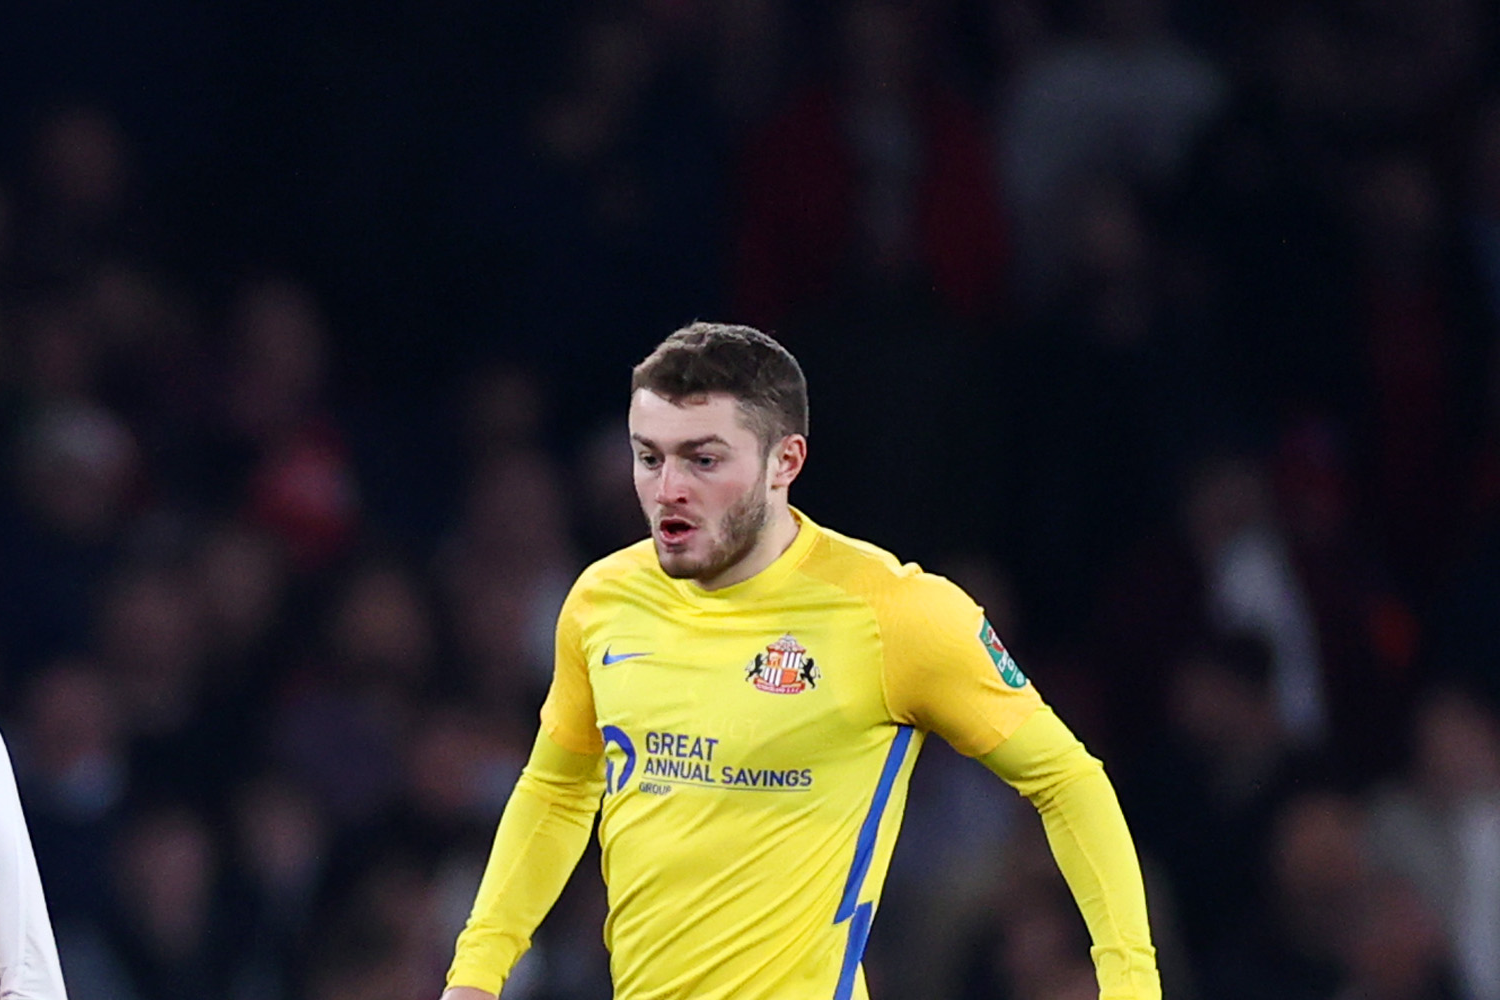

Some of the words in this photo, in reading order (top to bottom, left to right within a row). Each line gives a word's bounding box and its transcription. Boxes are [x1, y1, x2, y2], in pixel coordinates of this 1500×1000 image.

[645, 732, 719, 761] GREAT
[643, 757, 715, 783] ANNUAL
[721, 766, 813, 787] SAVINGS
[638, 781, 673, 796] GROUP
